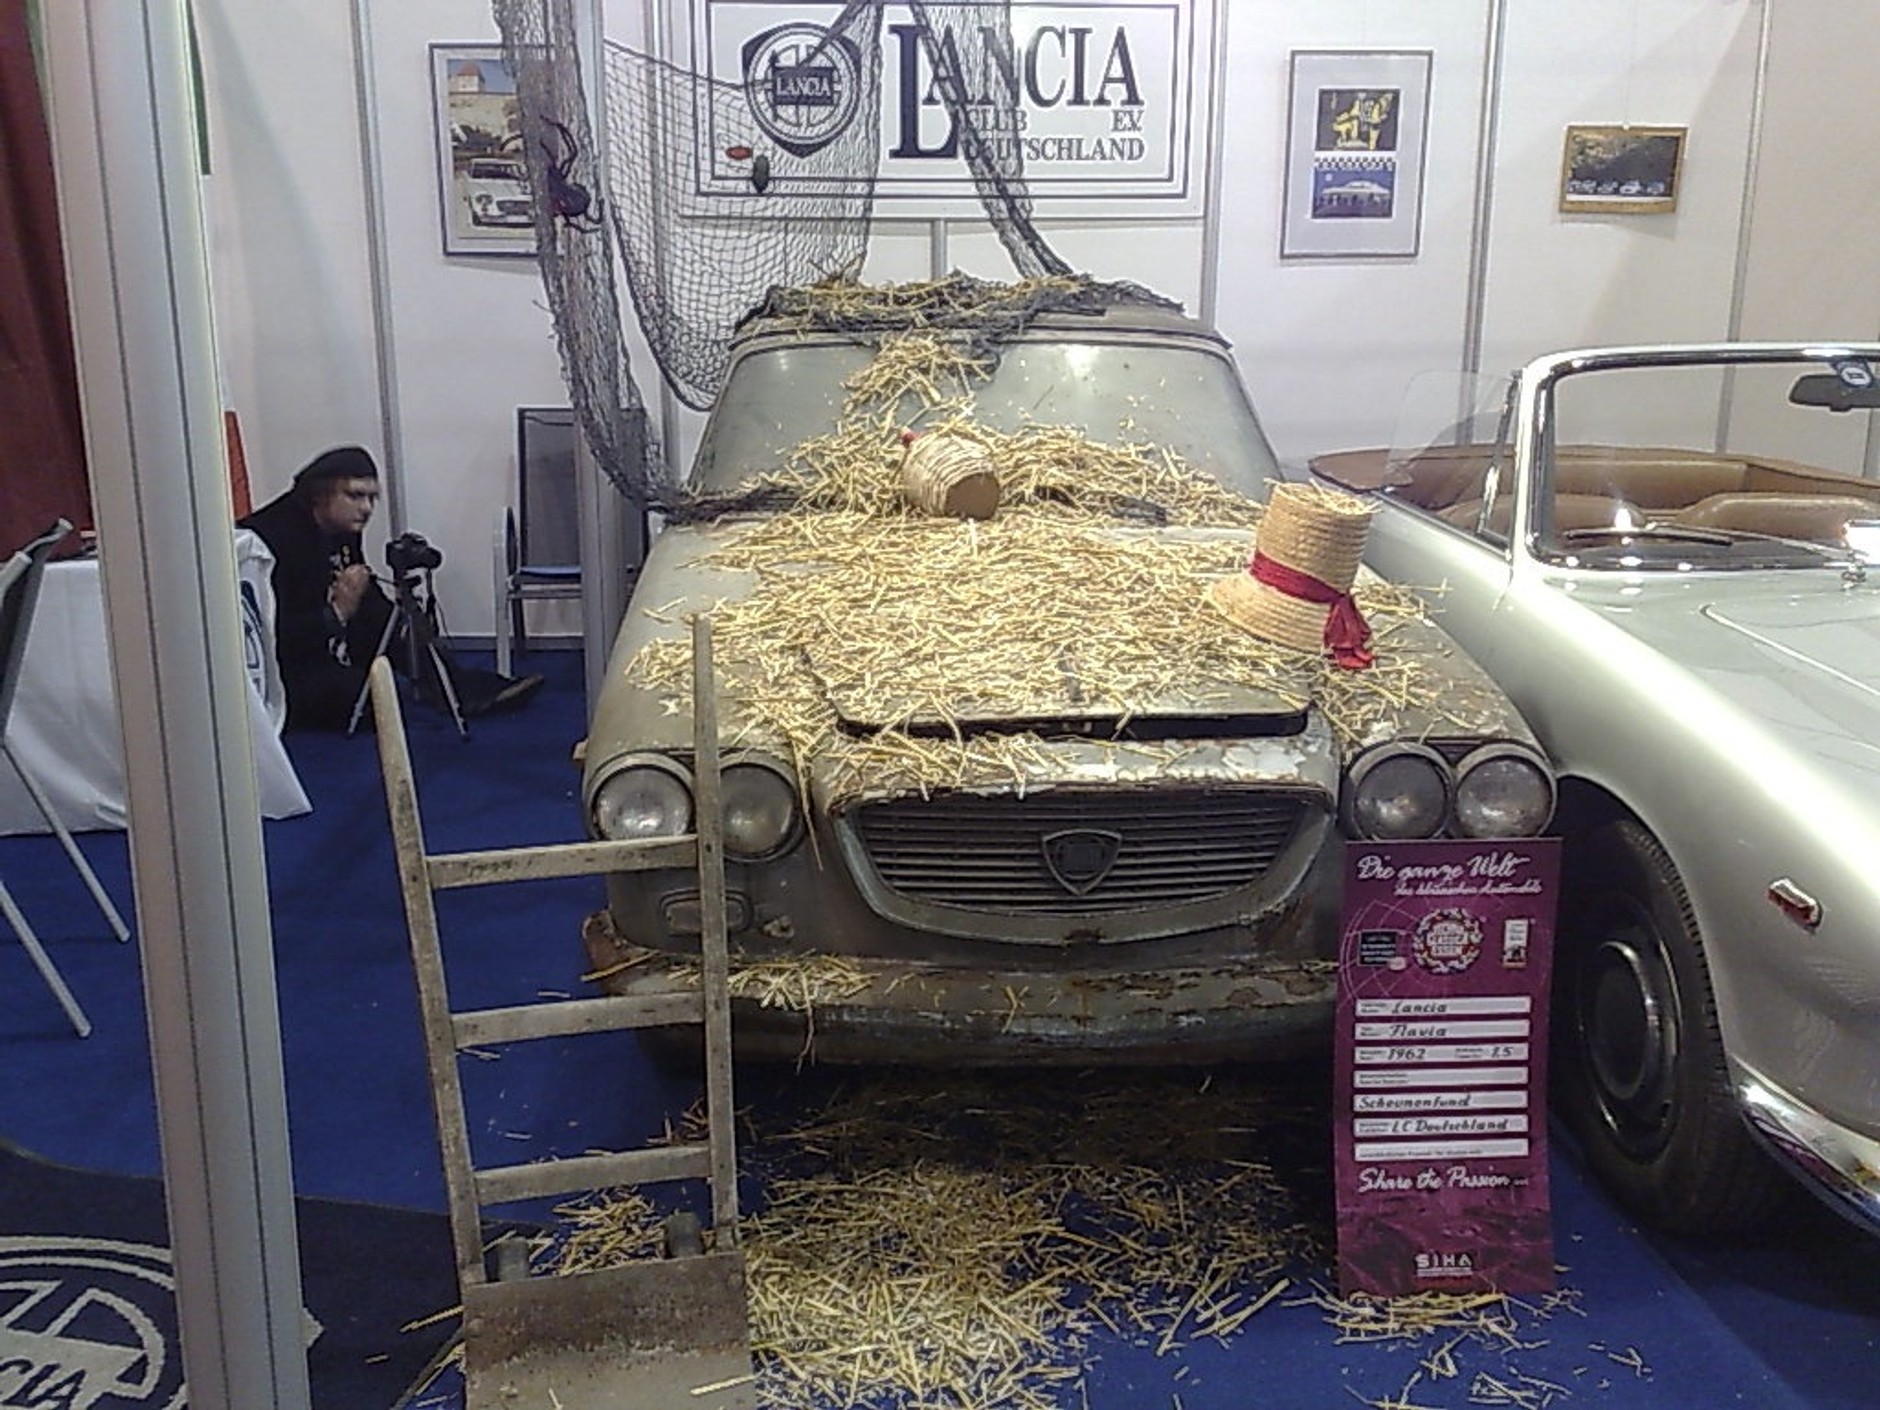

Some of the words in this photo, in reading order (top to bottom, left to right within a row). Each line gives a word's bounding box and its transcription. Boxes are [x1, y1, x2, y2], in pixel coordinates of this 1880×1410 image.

[889, 24, 1145, 160] LANCIA
[1358, 855, 1395, 879] Die
[1467, 852, 1530, 877] Welt
[1392, 1001, 1448, 1015] Lancia
[1389, 1024, 1447, 1037] Flavia
[1388, 1048, 1426, 1060] 1962
[1358, 1167, 1412, 1193] Share
[1416, 1168, 1442, 1189] the
